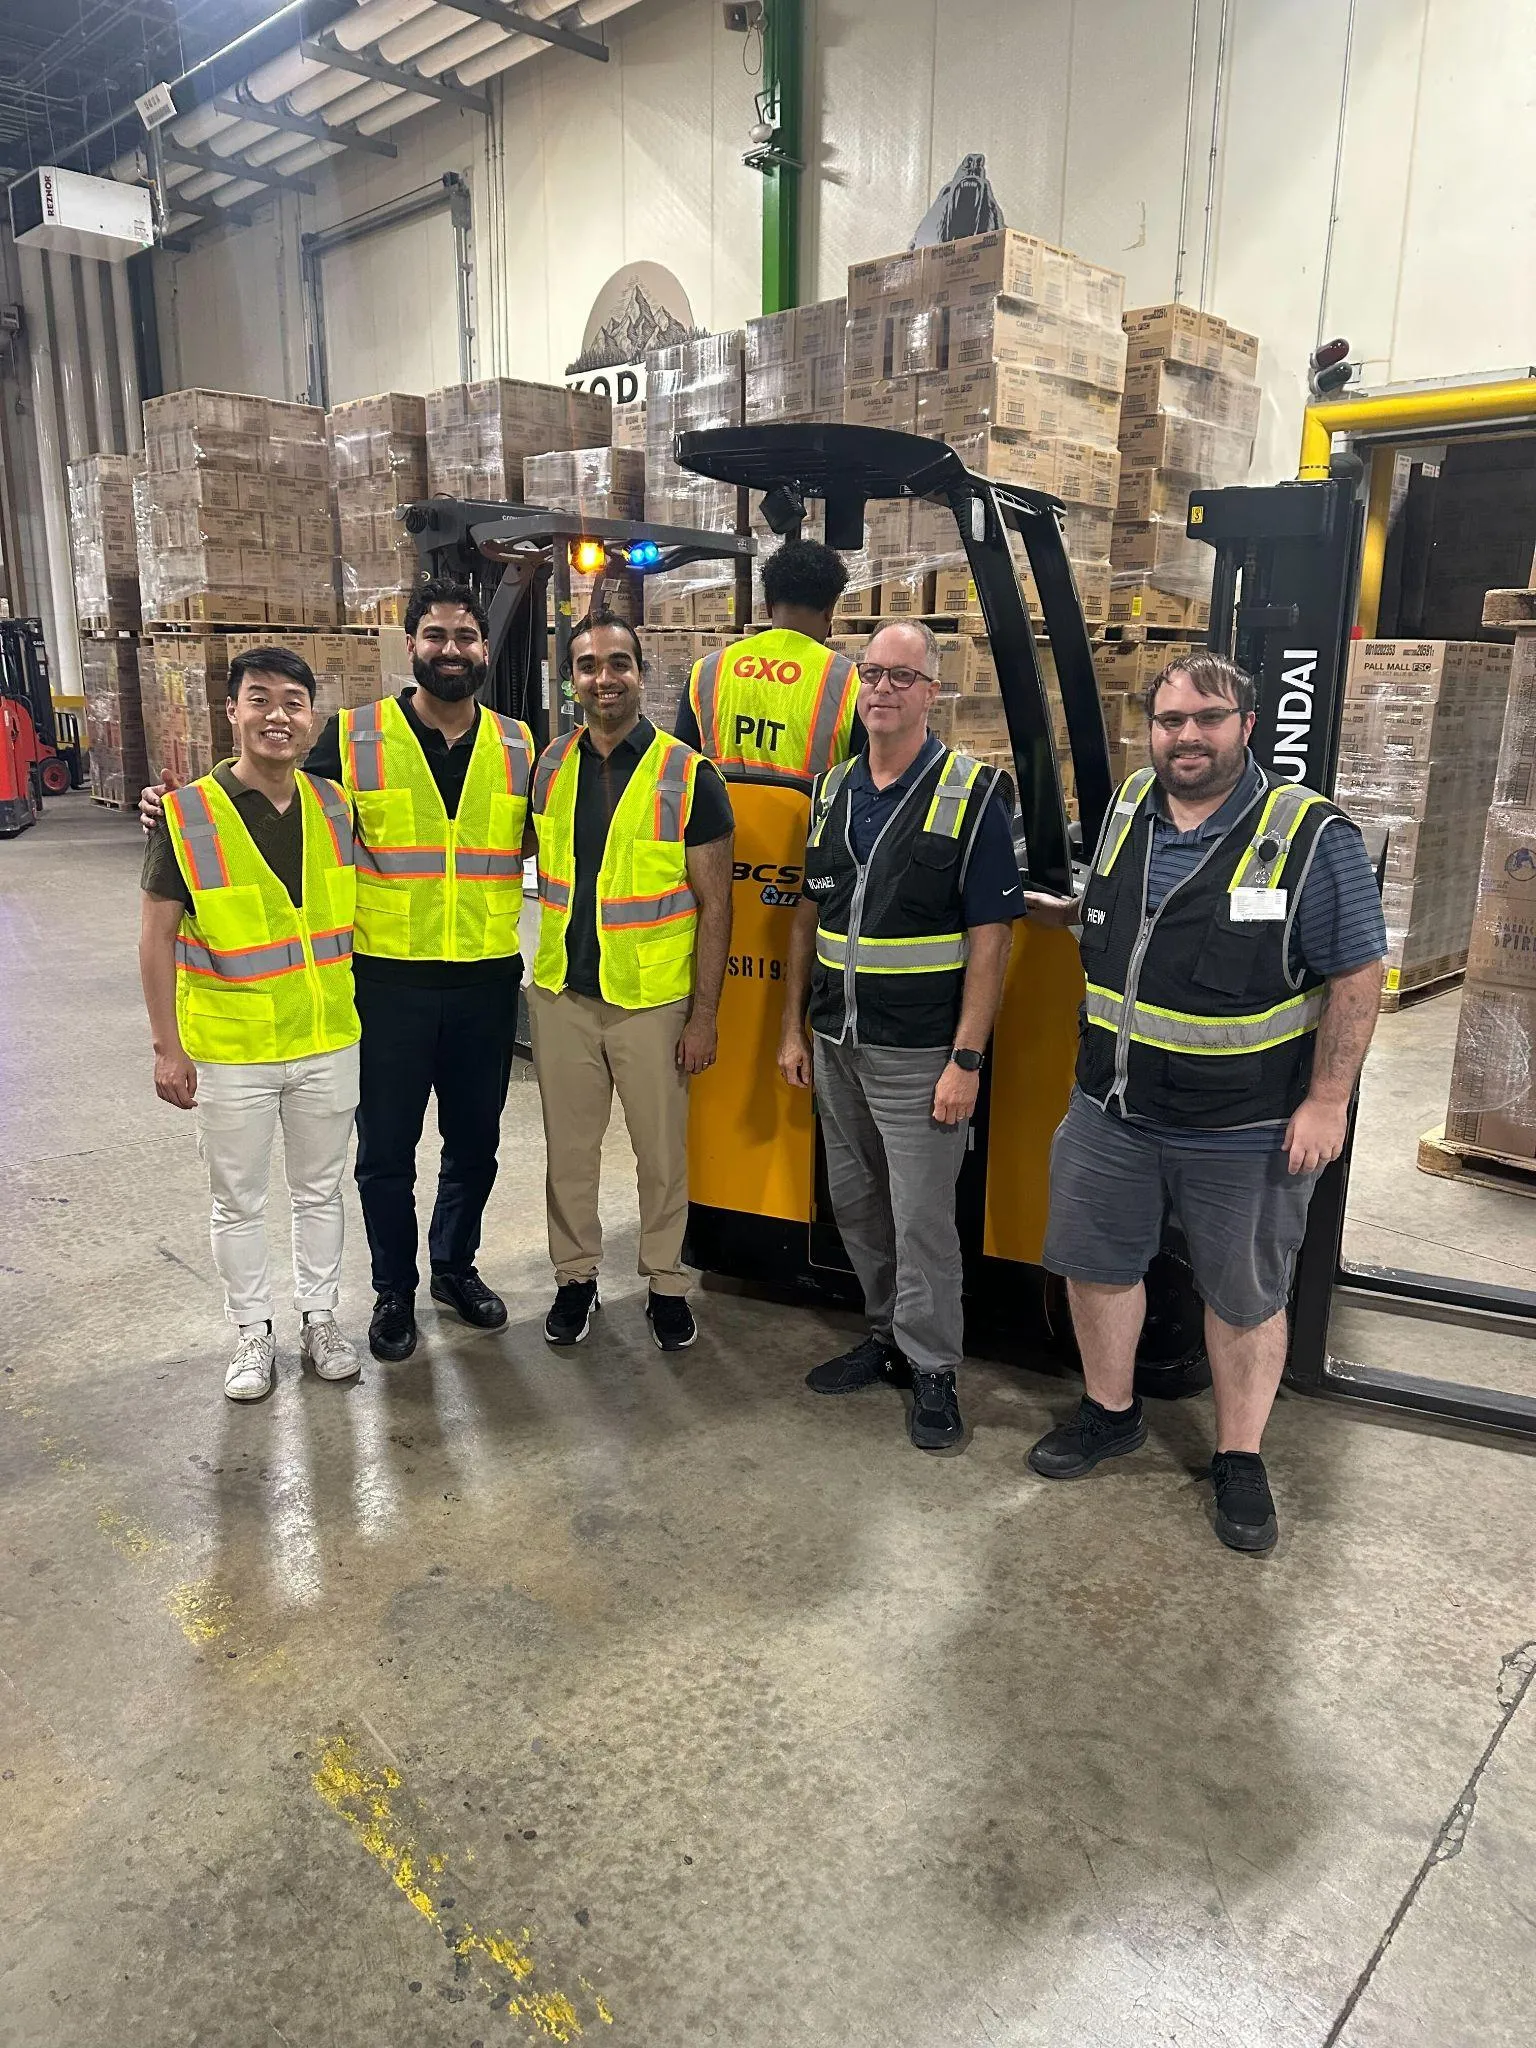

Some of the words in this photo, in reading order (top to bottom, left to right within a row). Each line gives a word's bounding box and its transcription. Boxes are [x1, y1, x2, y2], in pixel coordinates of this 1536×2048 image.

[43, 175, 55, 217] REZNOR
[734, 656, 802, 685] GXO
[1387, 663, 1410, 671] MALL
[1412, 663, 1431, 671] FSC
[734, 715, 785, 752] PIT
[732, 862, 803, 884] BCS
[1087, 908, 1106, 925] HEW
[728, 956, 788, 981] SR19
